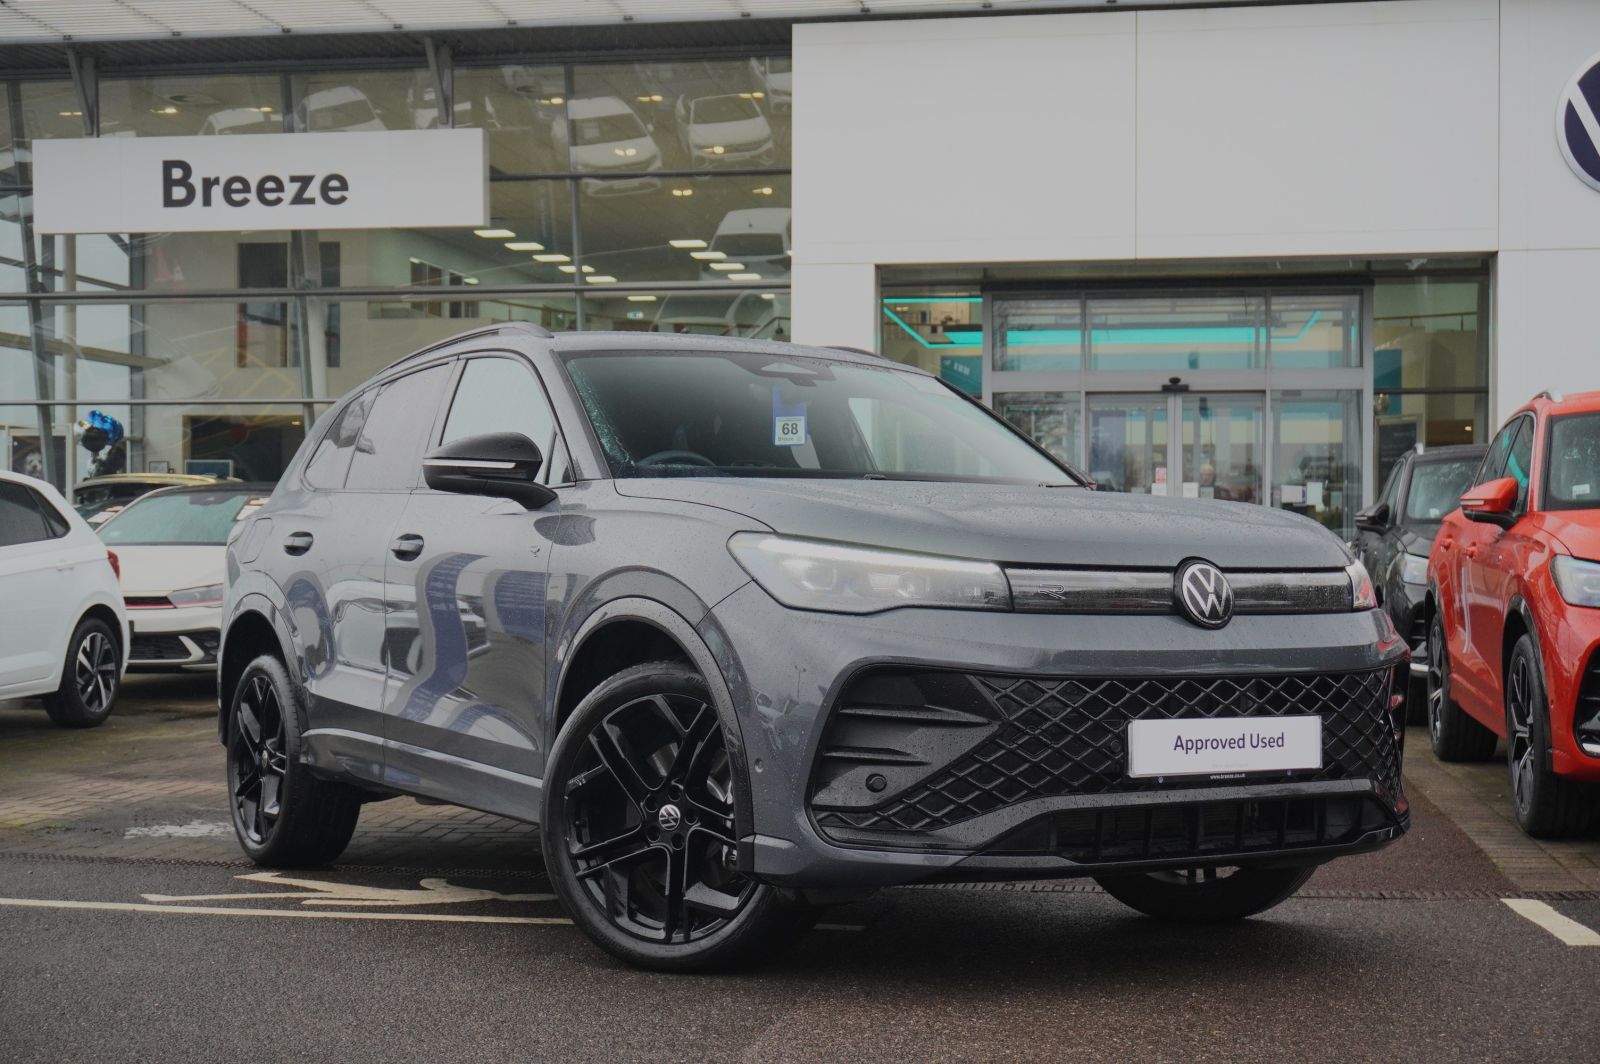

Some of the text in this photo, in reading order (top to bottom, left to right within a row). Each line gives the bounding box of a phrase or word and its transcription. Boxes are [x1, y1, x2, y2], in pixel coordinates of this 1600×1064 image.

[162, 159, 350, 208] Breeze
[781, 422, 799, 436] 68
[1173, 731, 1285, 755] Approved Used
